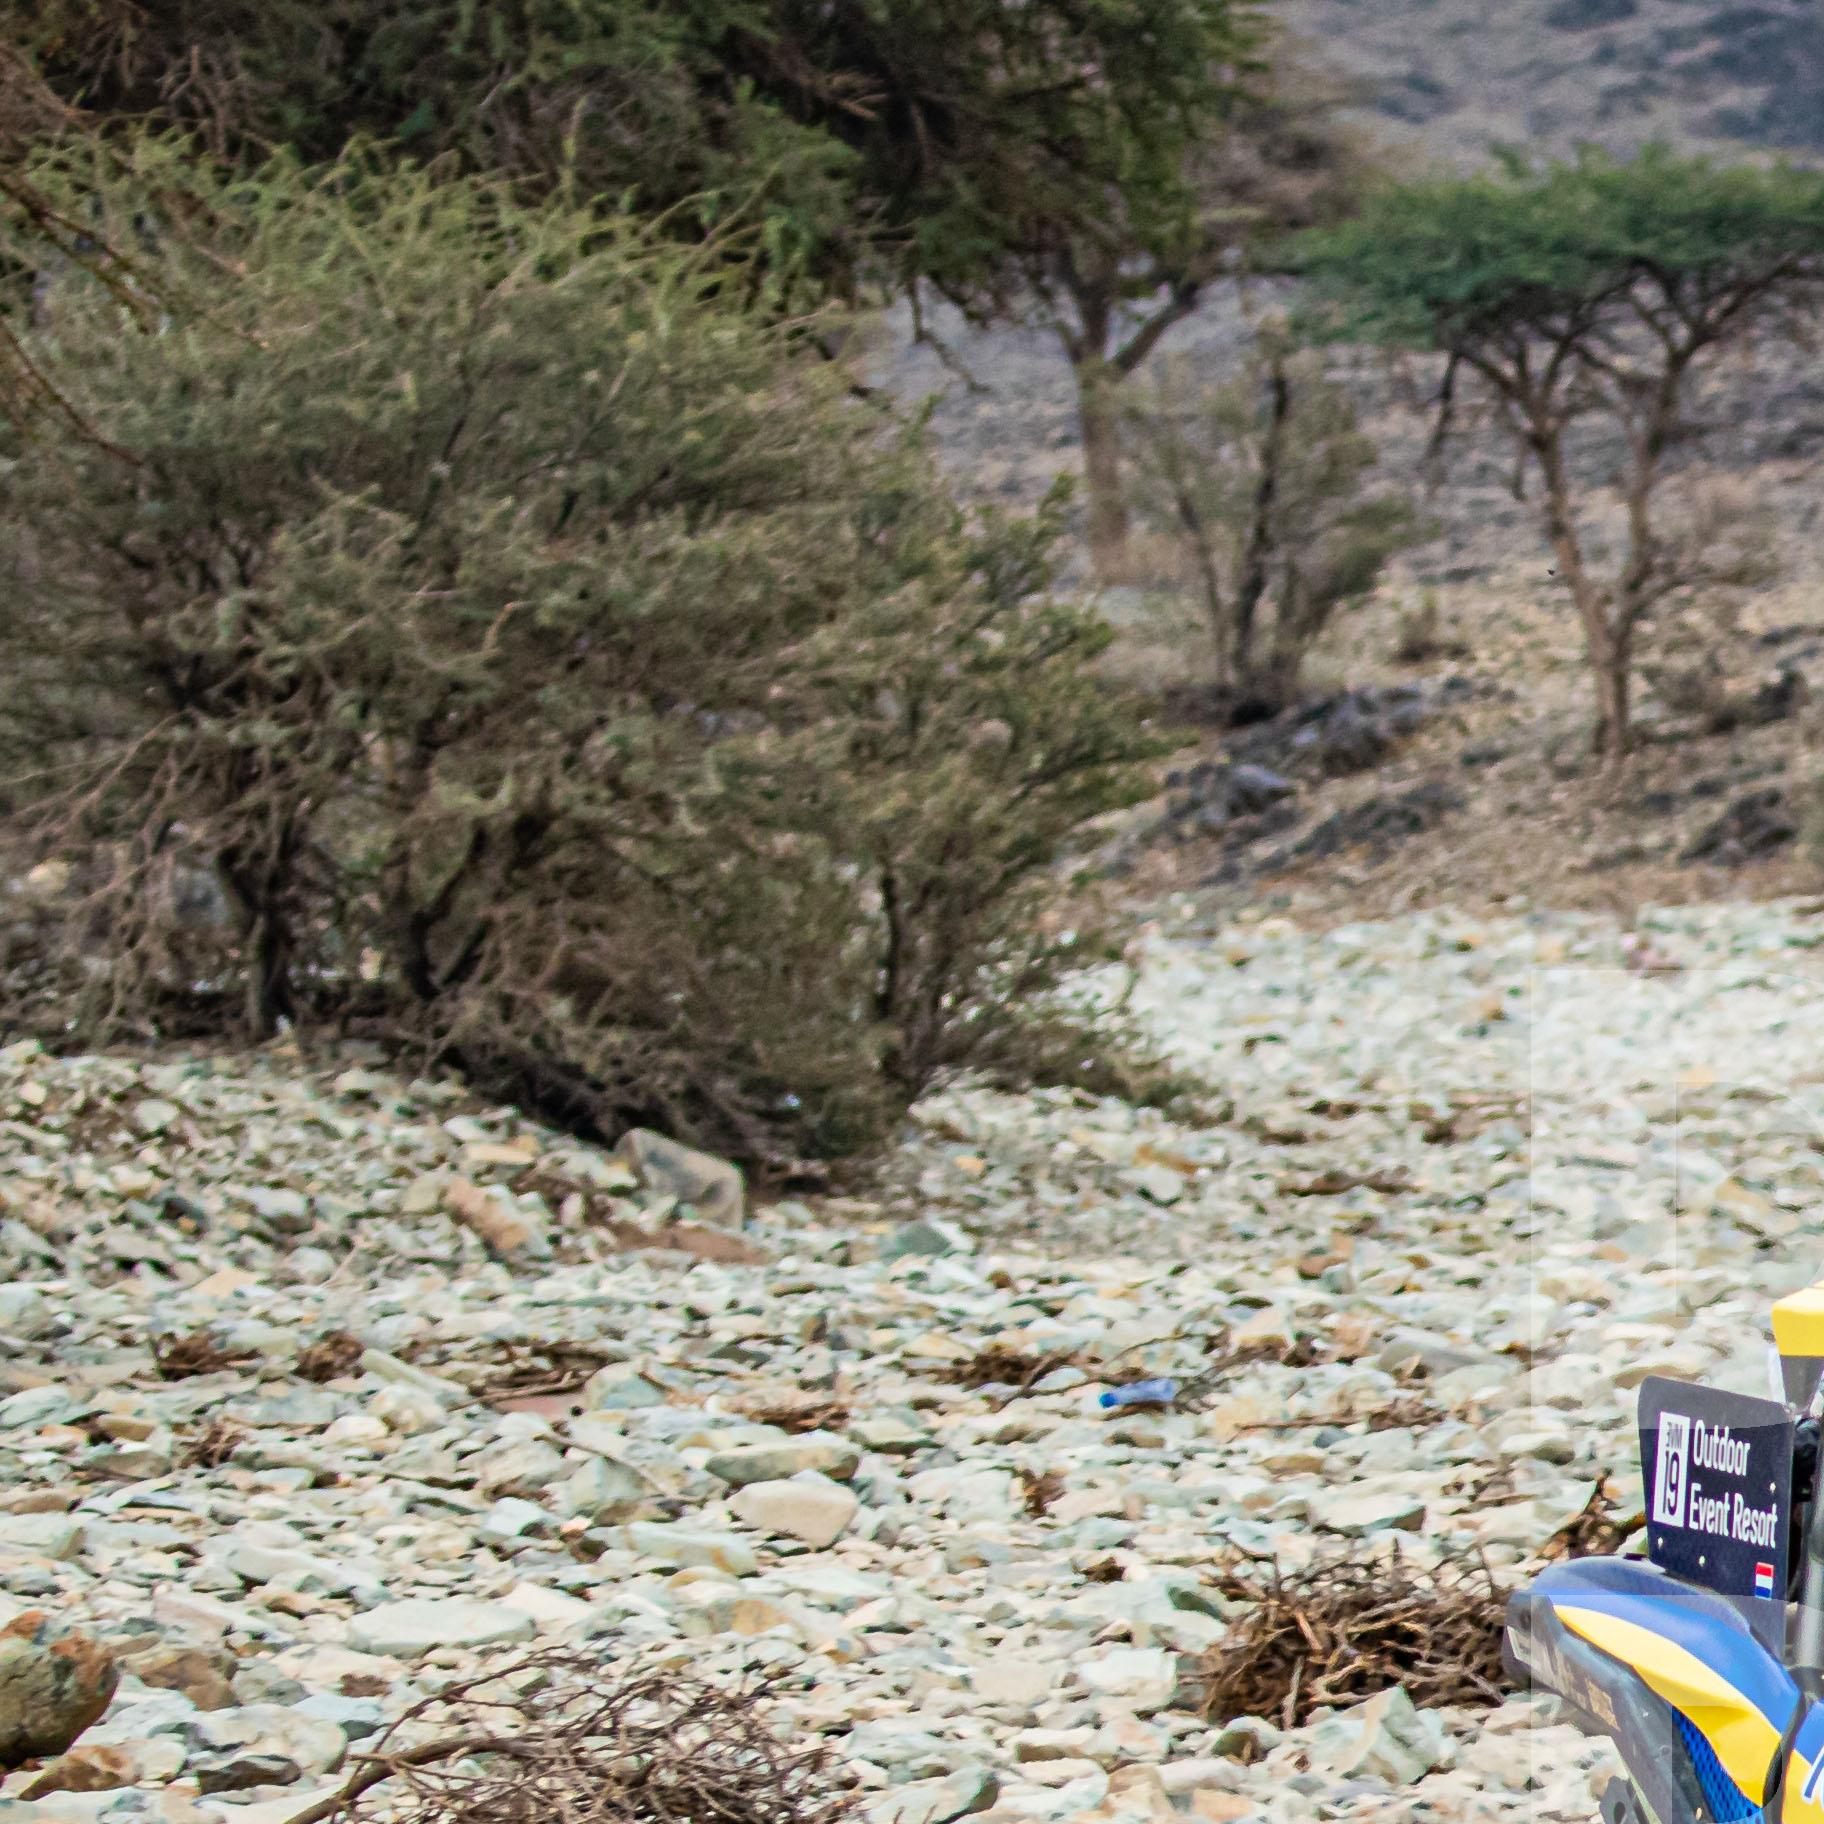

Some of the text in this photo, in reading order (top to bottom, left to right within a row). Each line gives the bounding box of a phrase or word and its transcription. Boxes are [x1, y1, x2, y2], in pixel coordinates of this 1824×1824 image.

[1693, 1419, 1751, 1477] Outdoor
[1661, 1450, 1681, 1516] 19
[1688, 1482, 1779, 1550] Event Resort
